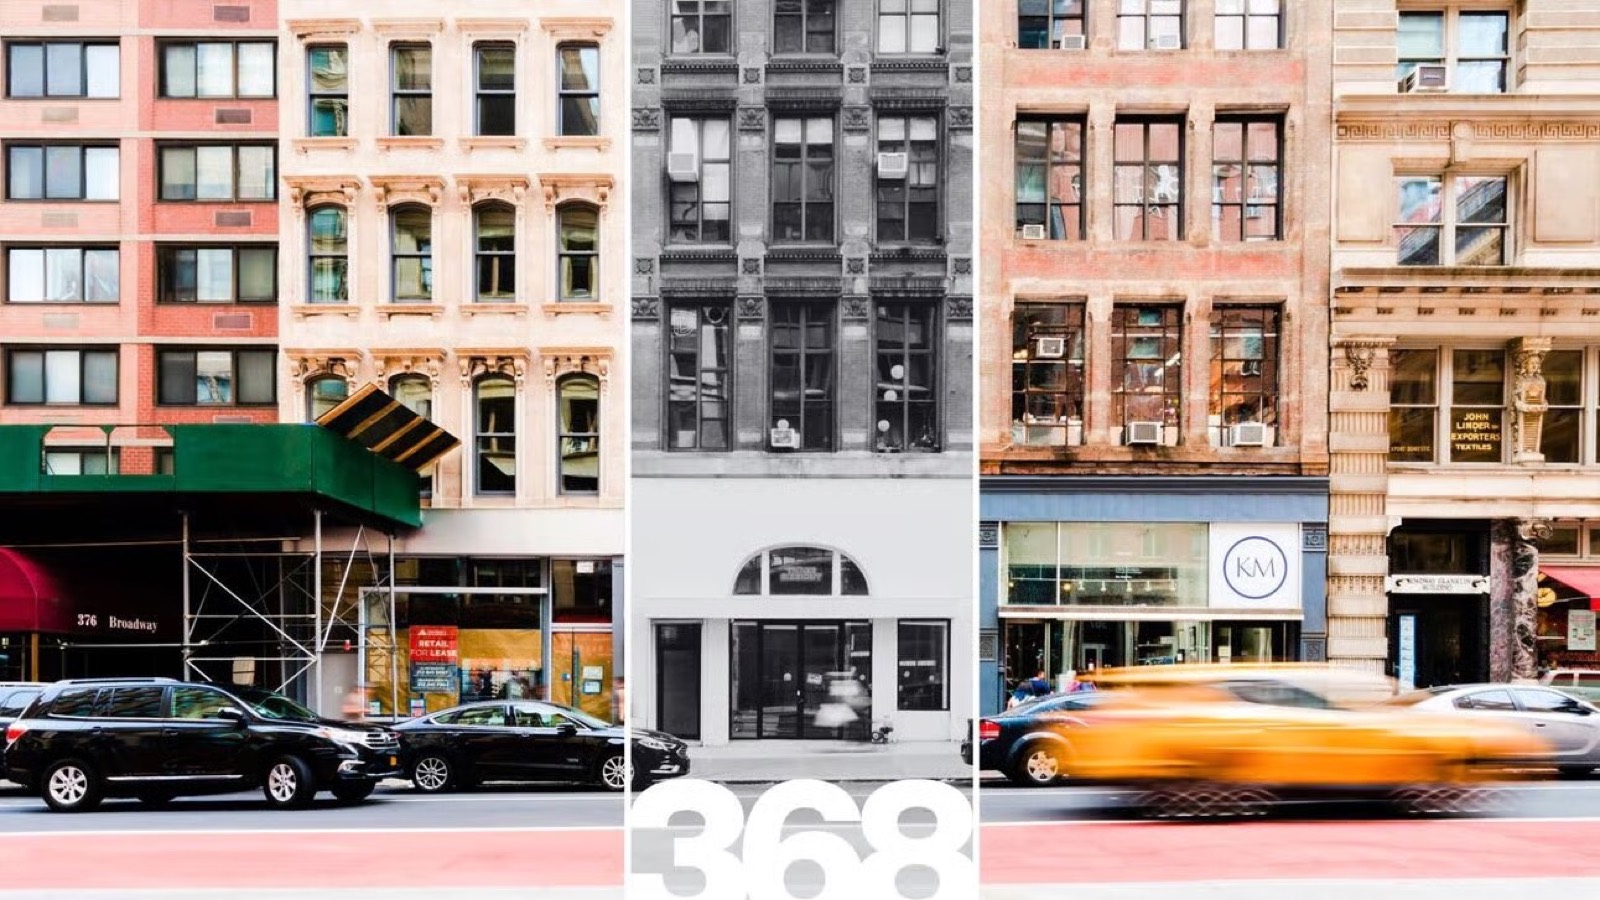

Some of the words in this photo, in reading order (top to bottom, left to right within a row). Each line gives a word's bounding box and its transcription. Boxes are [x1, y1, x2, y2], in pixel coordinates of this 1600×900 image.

[1464, 412, 1489, 421] JOHN
[1455, 421, 1490, 430] LINDER
[1450, 432, 1500, 441] EXPORTERS
[1455, 443, 1492, 451] TEXTILES
[1237, 556, 1275, 578] KM
[77, 613, 98, 627] 376
[109, 615, 158, 634] Broadway
[418, 639, 449, 648] RETAIL
[410, 649, 428, 657] FOR
[431, 649, 457, 657] LEASE
